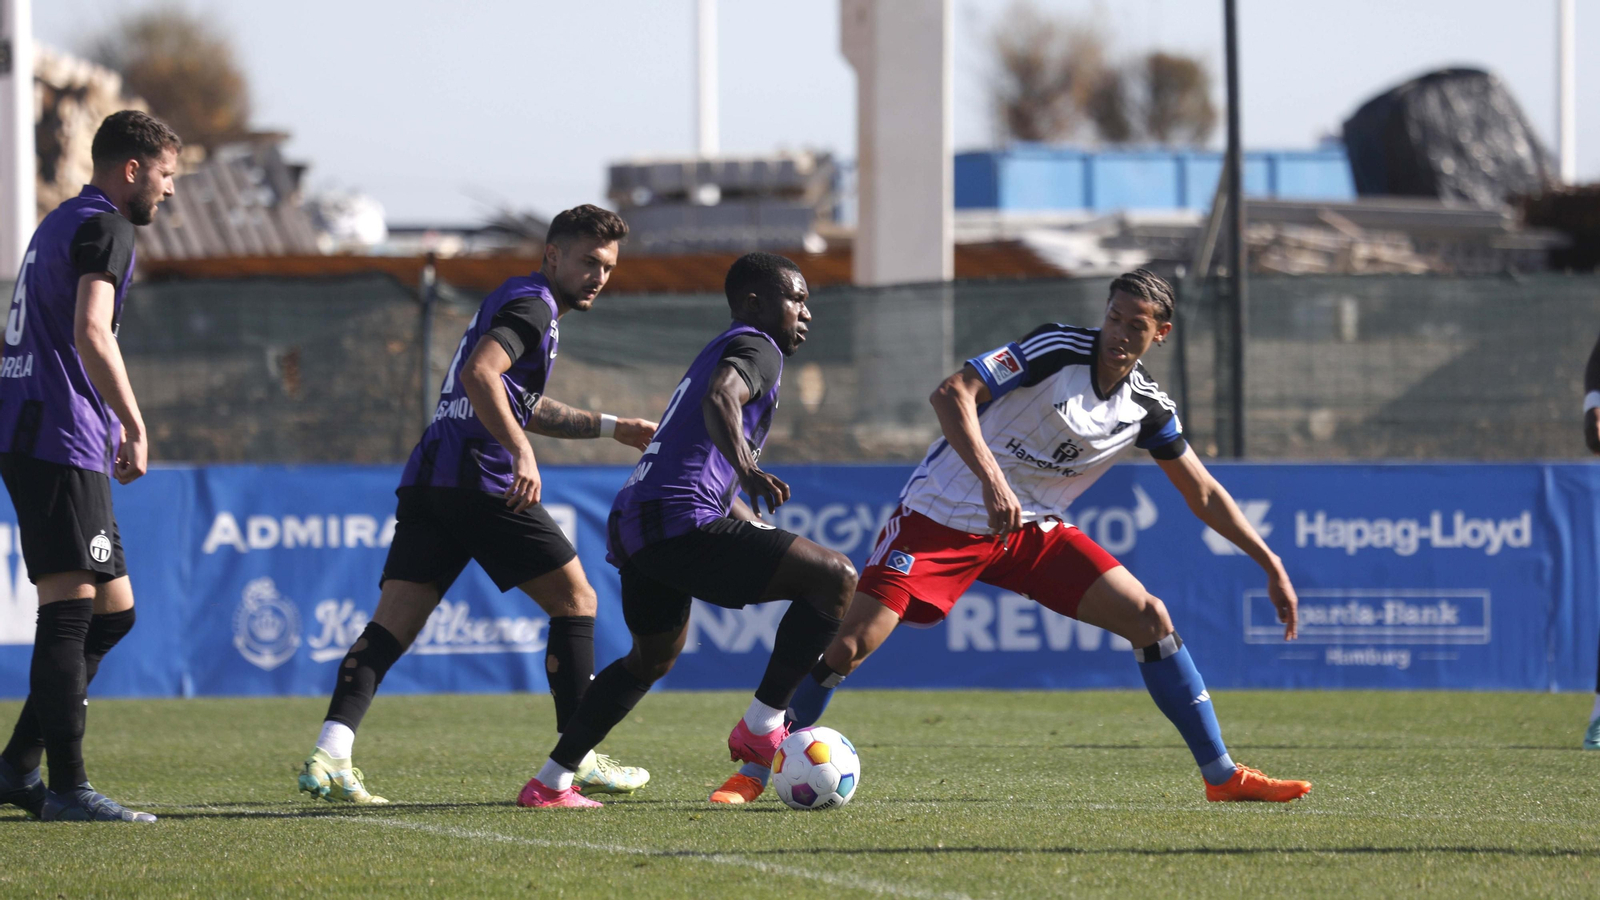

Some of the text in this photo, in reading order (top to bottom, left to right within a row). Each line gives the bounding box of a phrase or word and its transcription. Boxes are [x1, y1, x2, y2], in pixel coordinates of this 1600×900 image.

[1295, 509, 1532, 556] Hapag-Lloyd
[1275, 600, 1459, 630] parda-Bank
[1325, 648, 1411, 670] Hamburg
